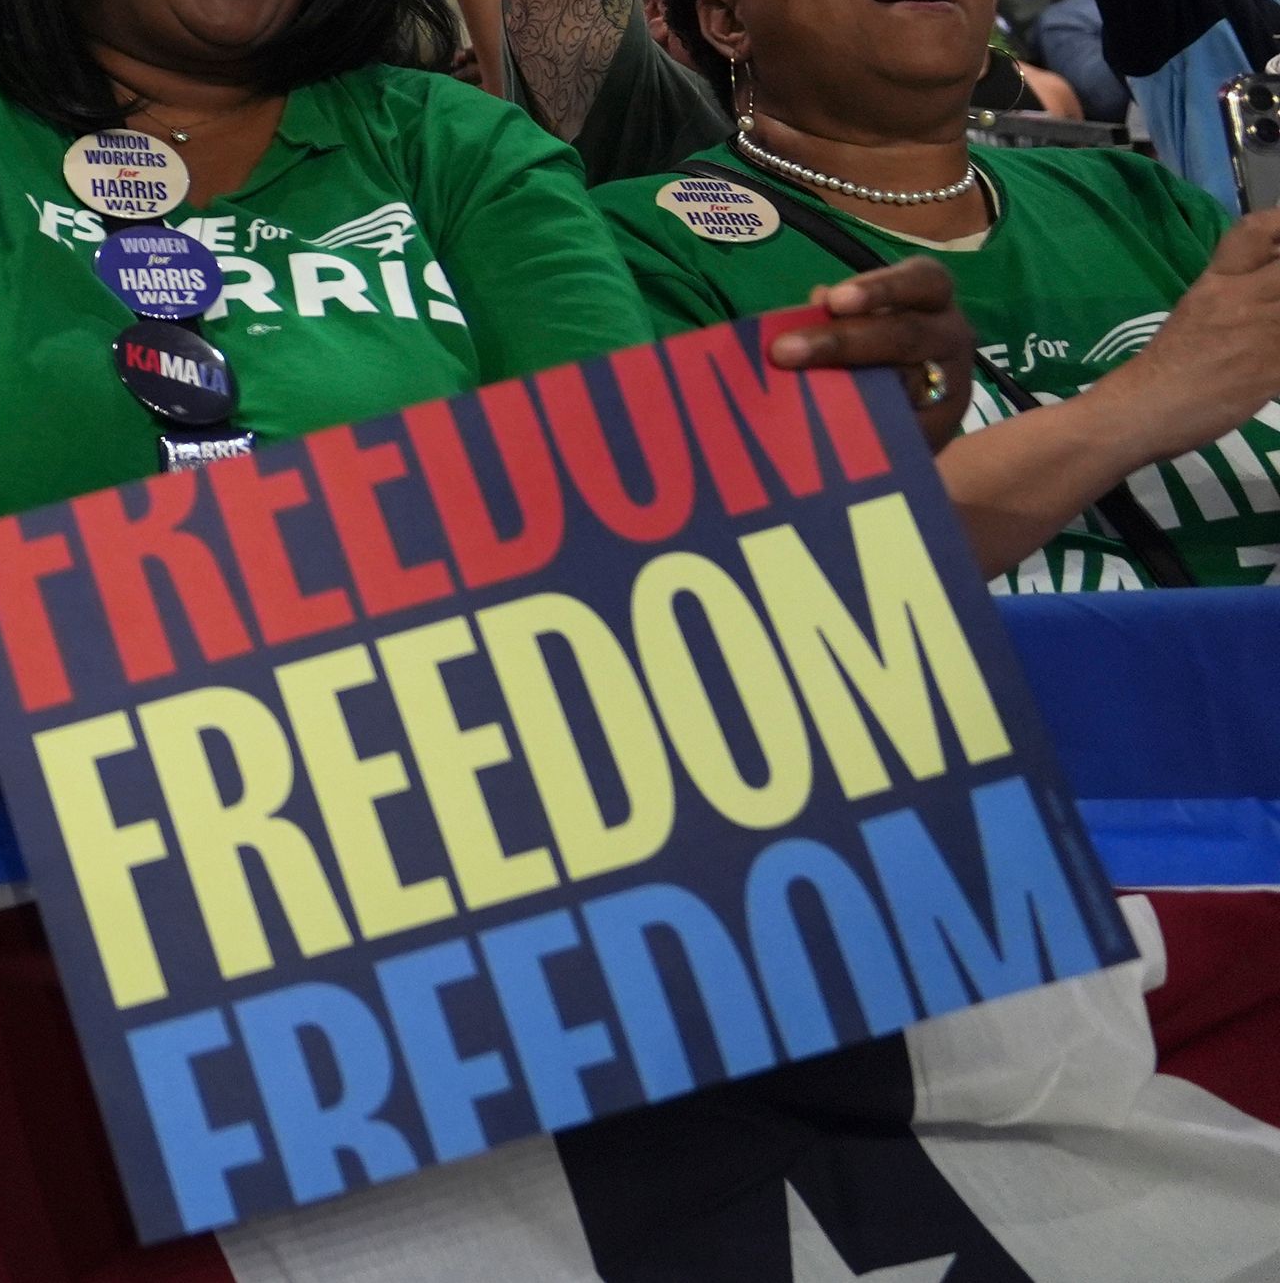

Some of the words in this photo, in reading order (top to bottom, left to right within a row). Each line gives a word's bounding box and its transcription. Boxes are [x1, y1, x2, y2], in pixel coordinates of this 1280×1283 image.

[96, 134, 150, 151] UNION
[83, 149, 167, 168] WORKERS
[116, 168, 140, 180] for
[91, 178, 168, 201] HARRIS
[679, 181, 733, 192] UNION
[672, 191, 754, 204] WORKERS
[104, 199, 158, 213] WALZ
[709, 204, 731, 212] for
[686, 211, 764, 227] HARRIS
[243, 219, 293, 253] for
[704, 225, 758, 236] WALZ
[119, 238, 190, 254] WOMEN
[146, 254, 172, 267] for
[118, 268, 207, 291] HARRIS
[135, 290, 199, 305] WALZ
[1019, 332, 1070, 373] for
[125, 342, 229, 397] KAMALA
[32, 492, 1012, 1011] FREEDOM
[126, 775, 1100, 1233] FREEDOM
